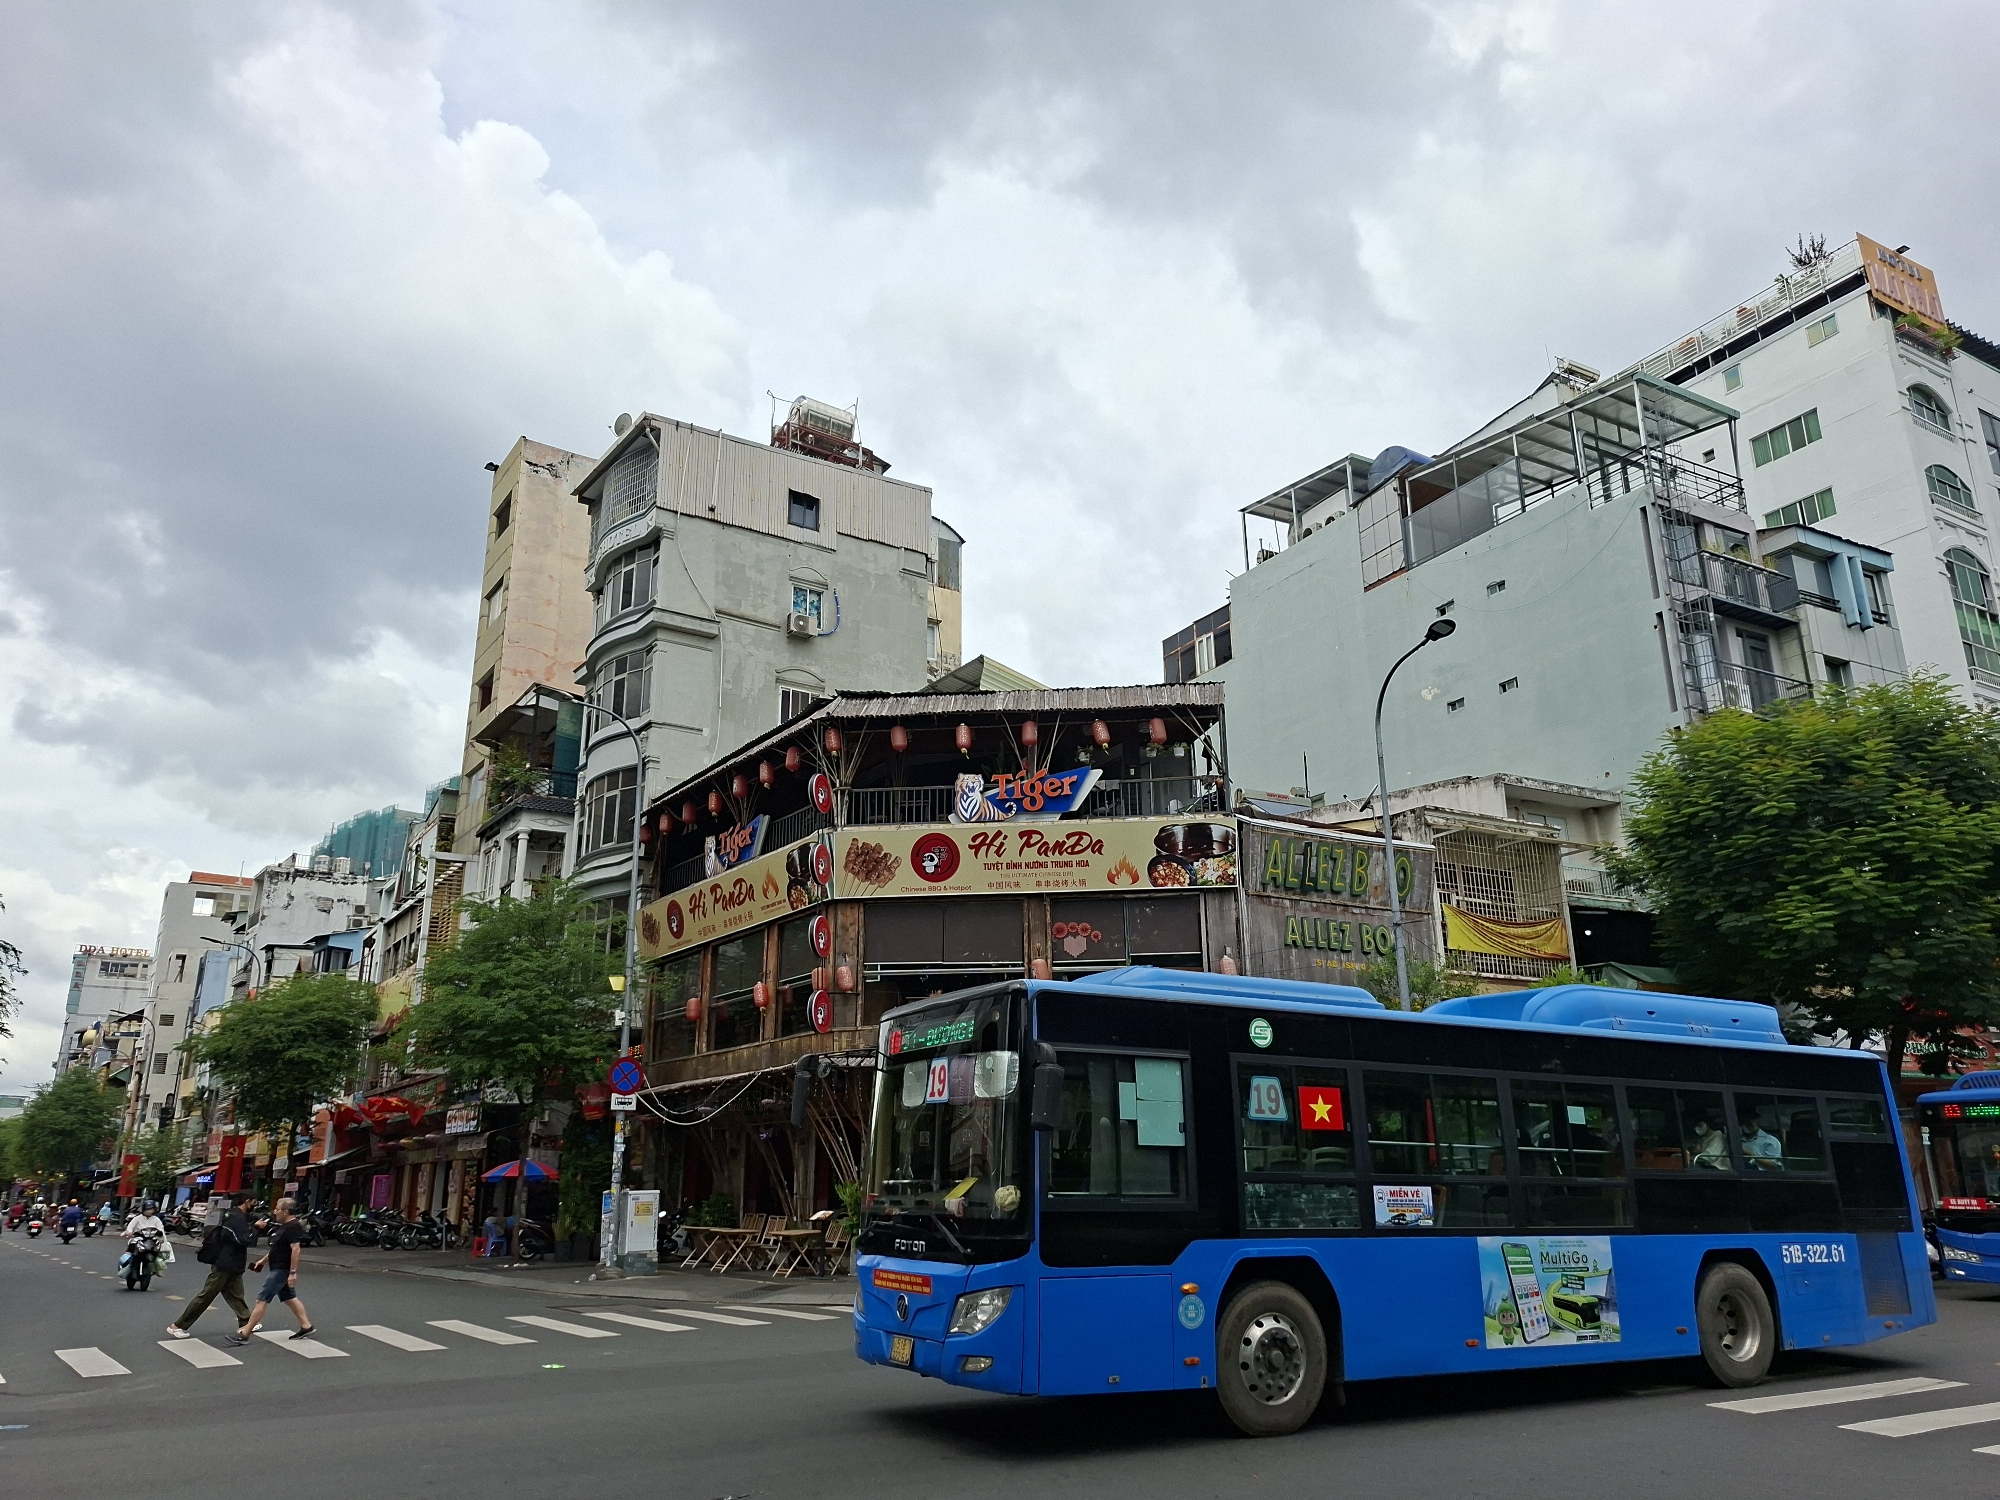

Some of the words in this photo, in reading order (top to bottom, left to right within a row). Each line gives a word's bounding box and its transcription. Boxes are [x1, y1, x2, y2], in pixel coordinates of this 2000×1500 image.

[990, 768, 1078, 811] Tiger
[718, 822, 753, 863] Tiger
[968, 829, 1009, 859] Hi
[1018, 829, 1105, 859] PanDa
[983, 861, 1004, 872] TUYỆT
[1050, 860, 1073, 869] TRUNG
[1075, 859, 1090, 868] HOA
[1261, 834, 1347, 894] ALLEZ
[688, 887, 708, 923] Hi
[709, 877, 756, 916] PanDa
[900, 885, 927, 893] Chinese
[1284, 914, 1354, 952] ALLEZ
[79, 944, 106, 954] DDA
[111, 946, 151, 958] HOTEL
[929, 1064, 947, 1098] 19
[1253, 1083, 1281, 1116] 19
[894, 1239, 926, 1253] FOTON
[1540, 1250, 1588, 1265] MultiGo
[1781, 1244, 1846, 1264] 51B-322.61
